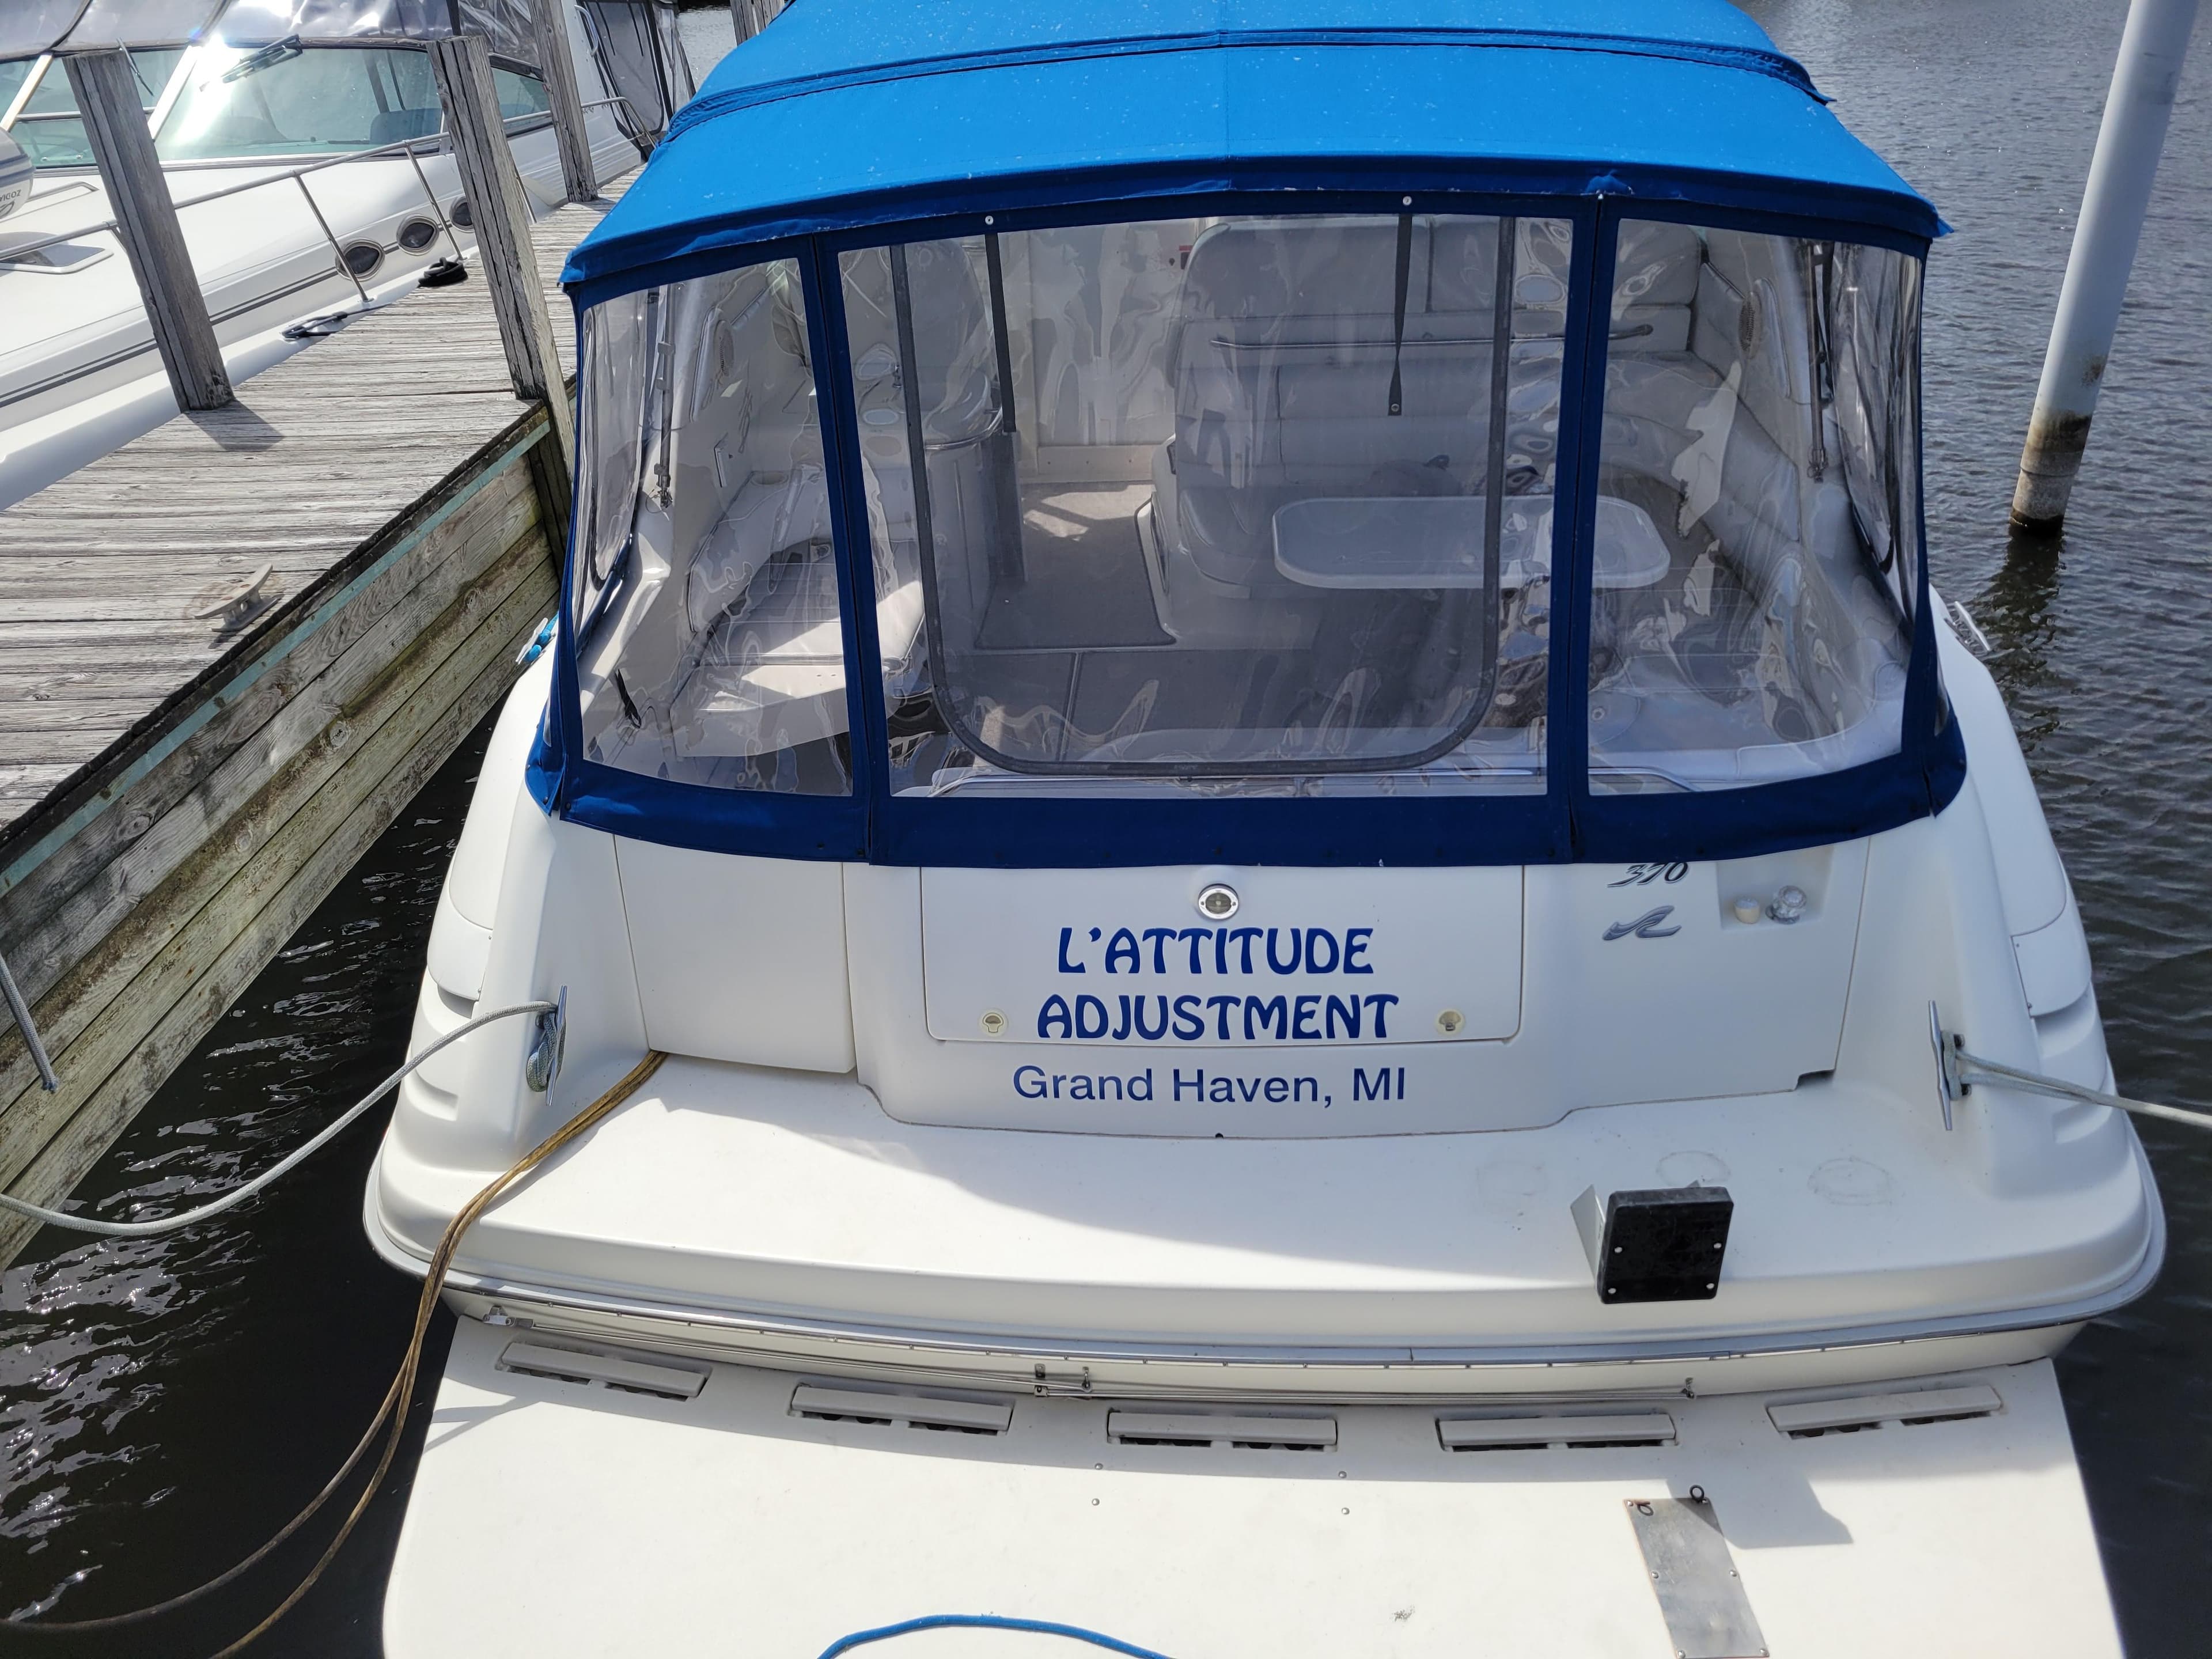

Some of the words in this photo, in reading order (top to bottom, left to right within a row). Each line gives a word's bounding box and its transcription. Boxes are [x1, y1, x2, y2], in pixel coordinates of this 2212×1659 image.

[1607, 862, 1688, 888] 370
[1058, 927, 1374, 975] L'ATTITUDE
[1037, 994, 1399, 1040] ADJUSTMENT
[1013, 1065, 1153, 1101] Grand
[1173, 1069, 1332, 1108] Haven,
[1353, 1067, 1406, 1101] MI
